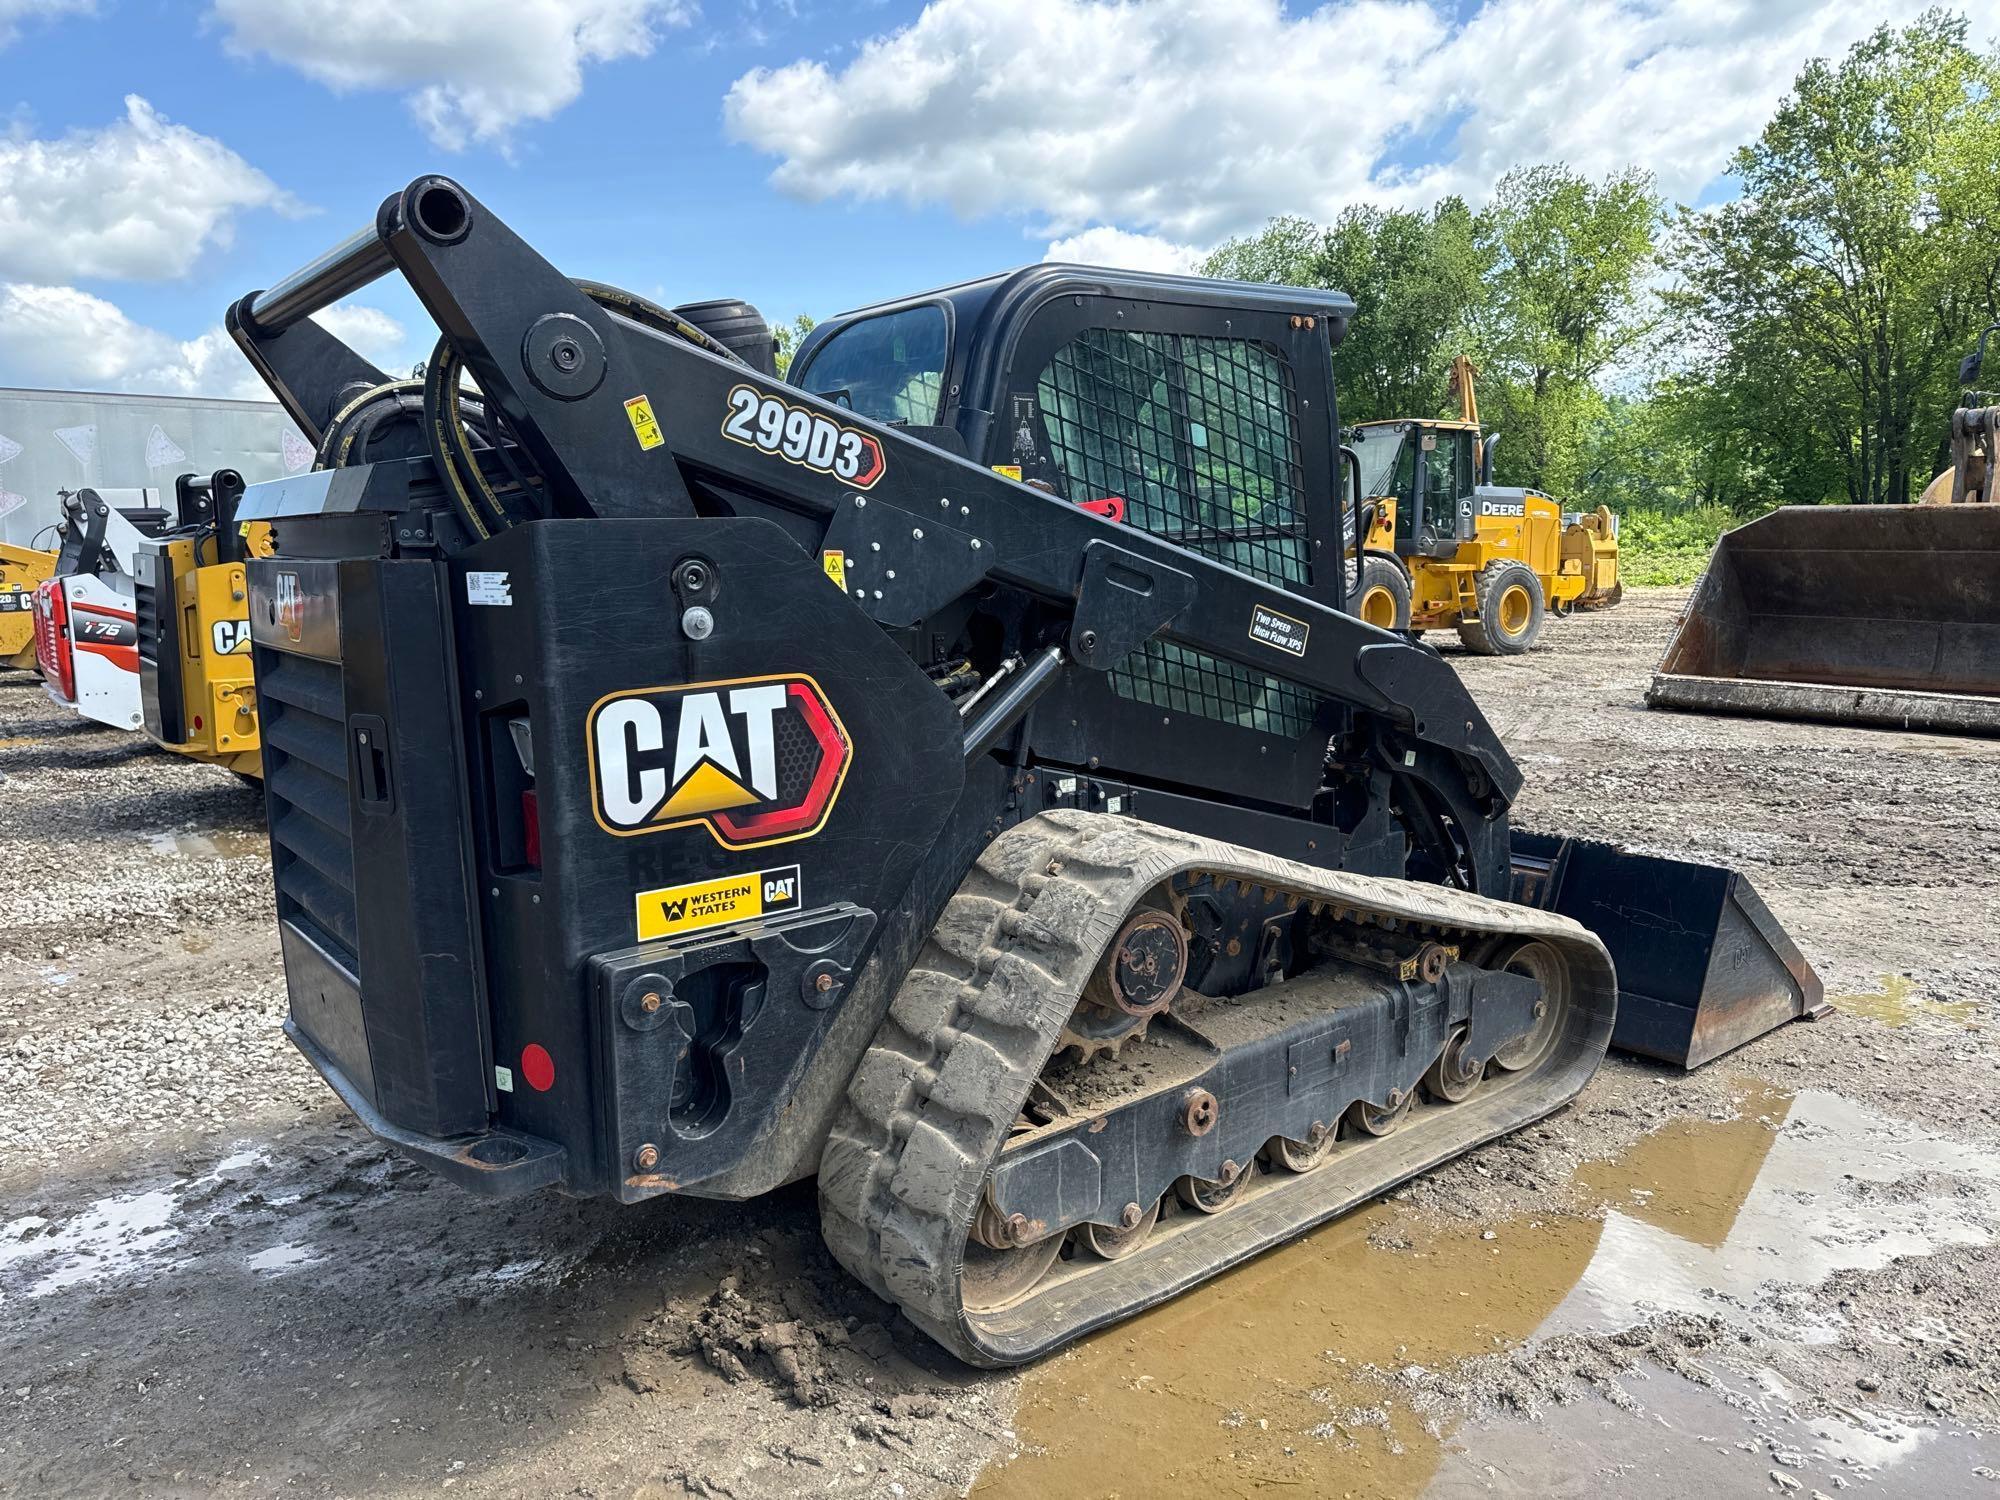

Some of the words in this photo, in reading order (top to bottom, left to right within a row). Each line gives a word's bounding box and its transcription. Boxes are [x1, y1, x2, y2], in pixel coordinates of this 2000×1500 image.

[726, 389, 863, 478] 299D3
[1482, 501, 1524, 517] DEERE
[277, 574, 296, 623] CAT
[85, 620, 122, 637] T76
[212, 621, 252, 655] CA
[1287, 637, 1303, 651] XPS
[596, 684, 787, 826] CAT
[690, 885, 751, 906] WESTERN
[764, 877, 795, 903] CAT
[690, 900, 736, 918] STATES
